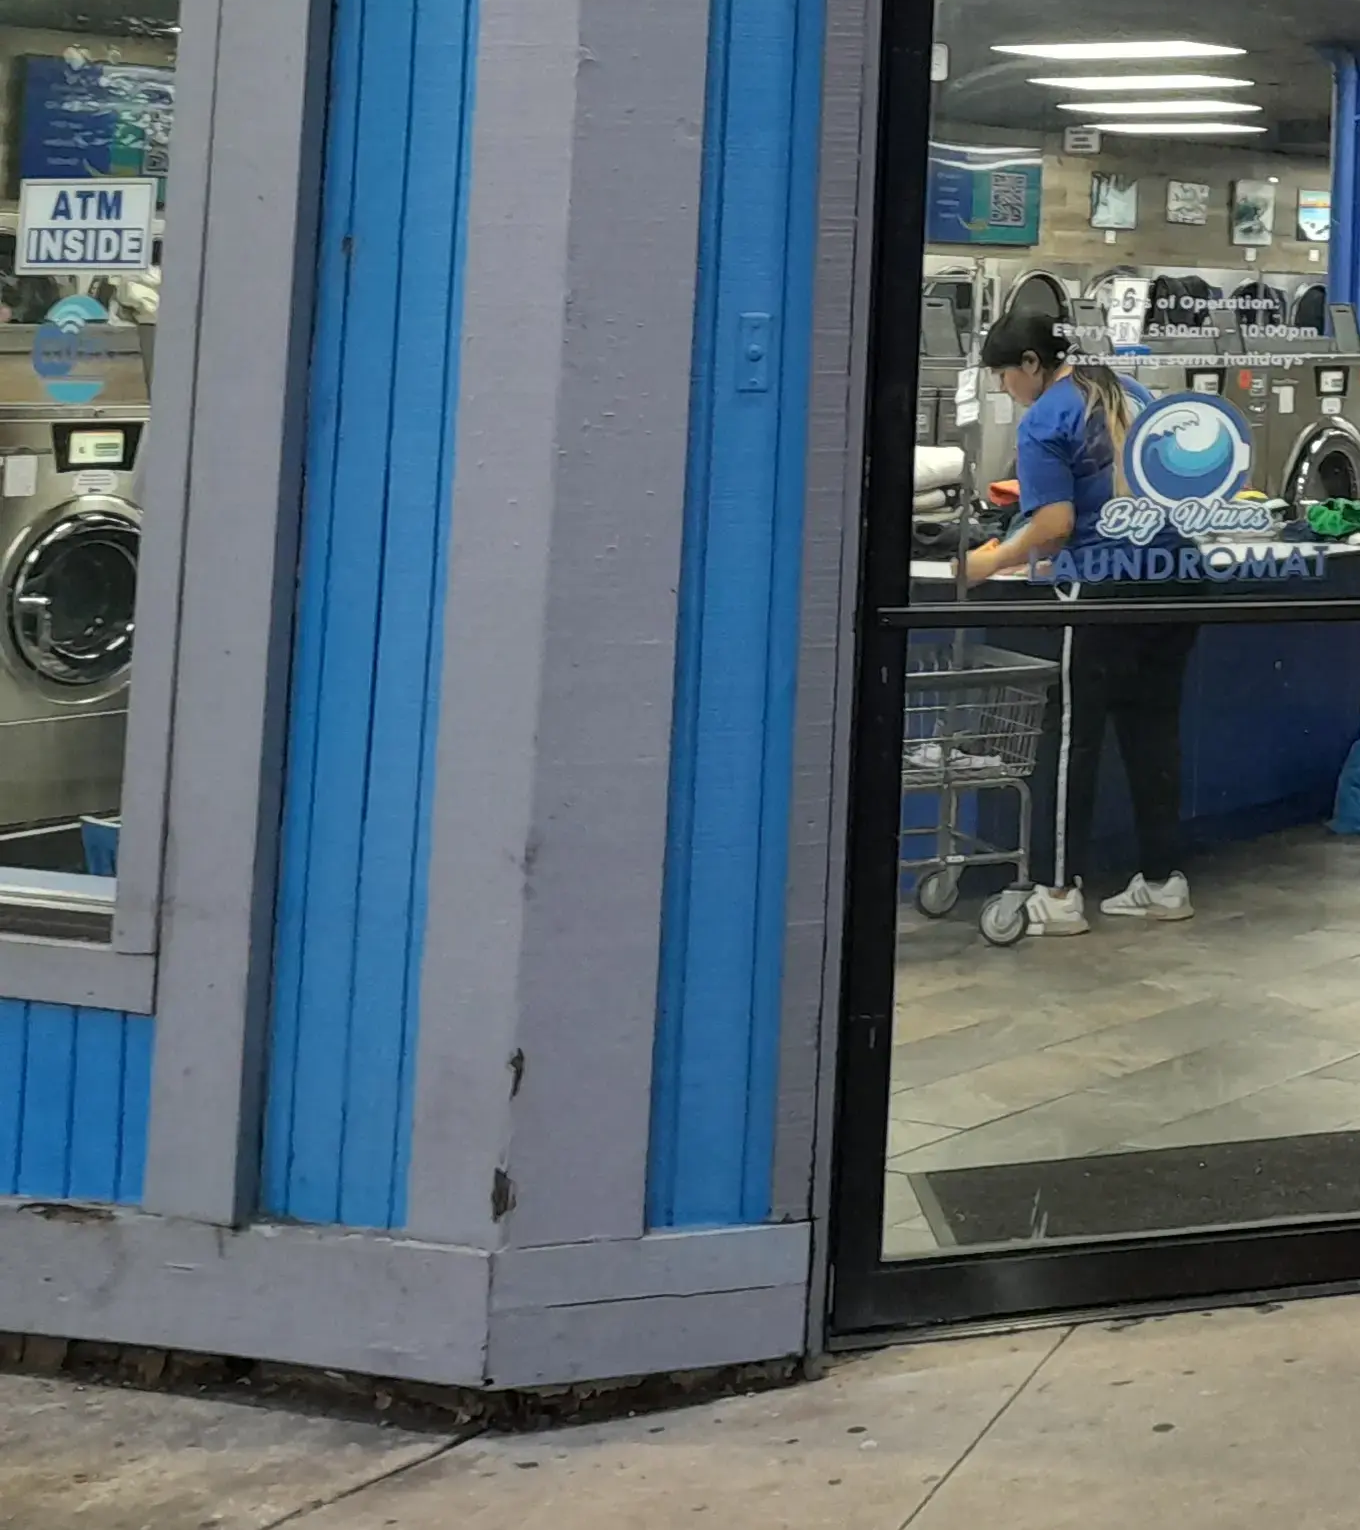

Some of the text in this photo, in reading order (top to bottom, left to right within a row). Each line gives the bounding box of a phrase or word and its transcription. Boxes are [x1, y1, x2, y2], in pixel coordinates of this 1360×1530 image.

[51, 189, 124, 221] ATM
[27, 229, 143, 262] INSIDE
[1156, 297, 1176, 310] of
[1240, 324, 1319, 341] 10:00pm
[1098, 498, 1271, 544] Big Waves
[1028, 545, 1329, 583] LAUNDROMAT
